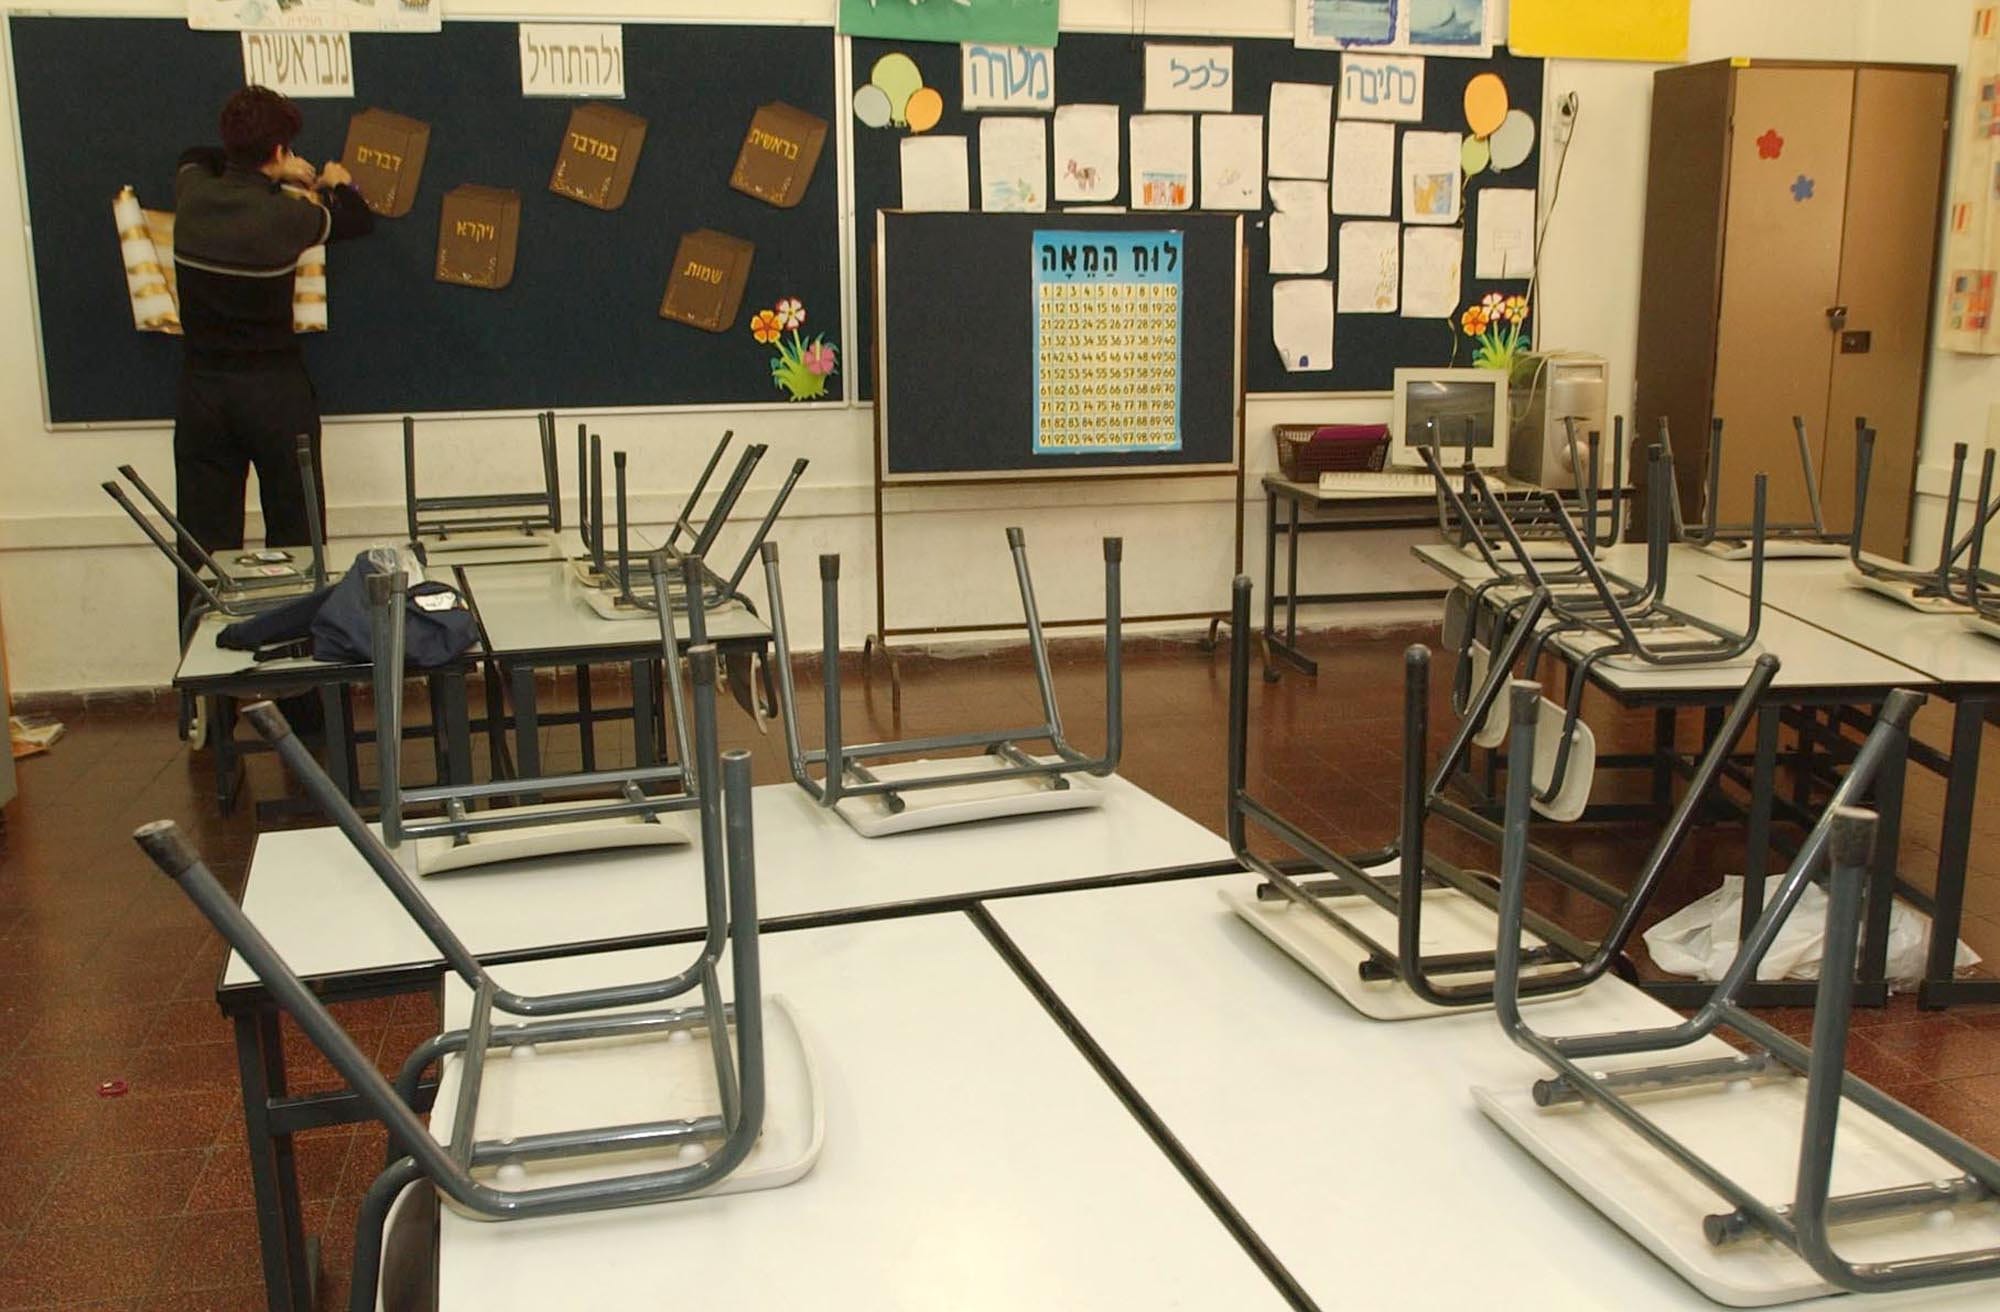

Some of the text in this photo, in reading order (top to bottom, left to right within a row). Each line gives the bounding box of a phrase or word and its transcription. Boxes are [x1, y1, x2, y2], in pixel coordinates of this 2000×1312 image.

[247, 33, 349, 85] מבראשית
[527, 32, 621, 84] ולהתחיל
[970, 46, 1048, 99] מטרה
[1170, 58, 1229, 90] לכל
[1346, 65, 1416, 105] כתיבה
[570, 132, 618, 162] במדבר
[747, 129, 799, 160] בראשית
[357, 146, 402, 172] דברים
[456, 221, 495, 243] ויקרא
[683, 261, 723, 284] שמות
[1043, 285, 1178, 298] 1 2 3 4 5 6 7 8 9 10
[1041, 302, 1177, 314] 11 12 13 14 15 16 17 18 19 20
[1041, 318, 1176, 330] 21 22 23 24 25 26 27 28 29 30
[1041, 334, 1176, 347] 31 32 33 34 35 36 37 38 39 40
[1041, 351, 1176, 363] 41 42 43 44 45 46 47 48 49 50
[1040, 367, 1176, 380] 51 52 53 54 55 56 57 58 59 60
[1040, 383, 1176, 396] 61 62 63 64 65 66 67 68 69 70
[1042, 400, 1176, 412] 71 72 73 74 75 76 77 78 79 80
[1040, 415, 1175, 429] 81 82 83 84 85 86 87 88 89 90
[1040, 434, 1051, 444] 91
[1054, 434, 1066, 445] 92
[1068, 433, 1080, 445] 93
[1082, 433, 1093, 444] 94
[1095, 432, 1108, 444] 95
[1109, 433, 1121, 444] 96
[1122, 432, 1134, 443] 97
[1136, 432, 1148, 442] 98
[1149, 431, 1162, 442] 99
